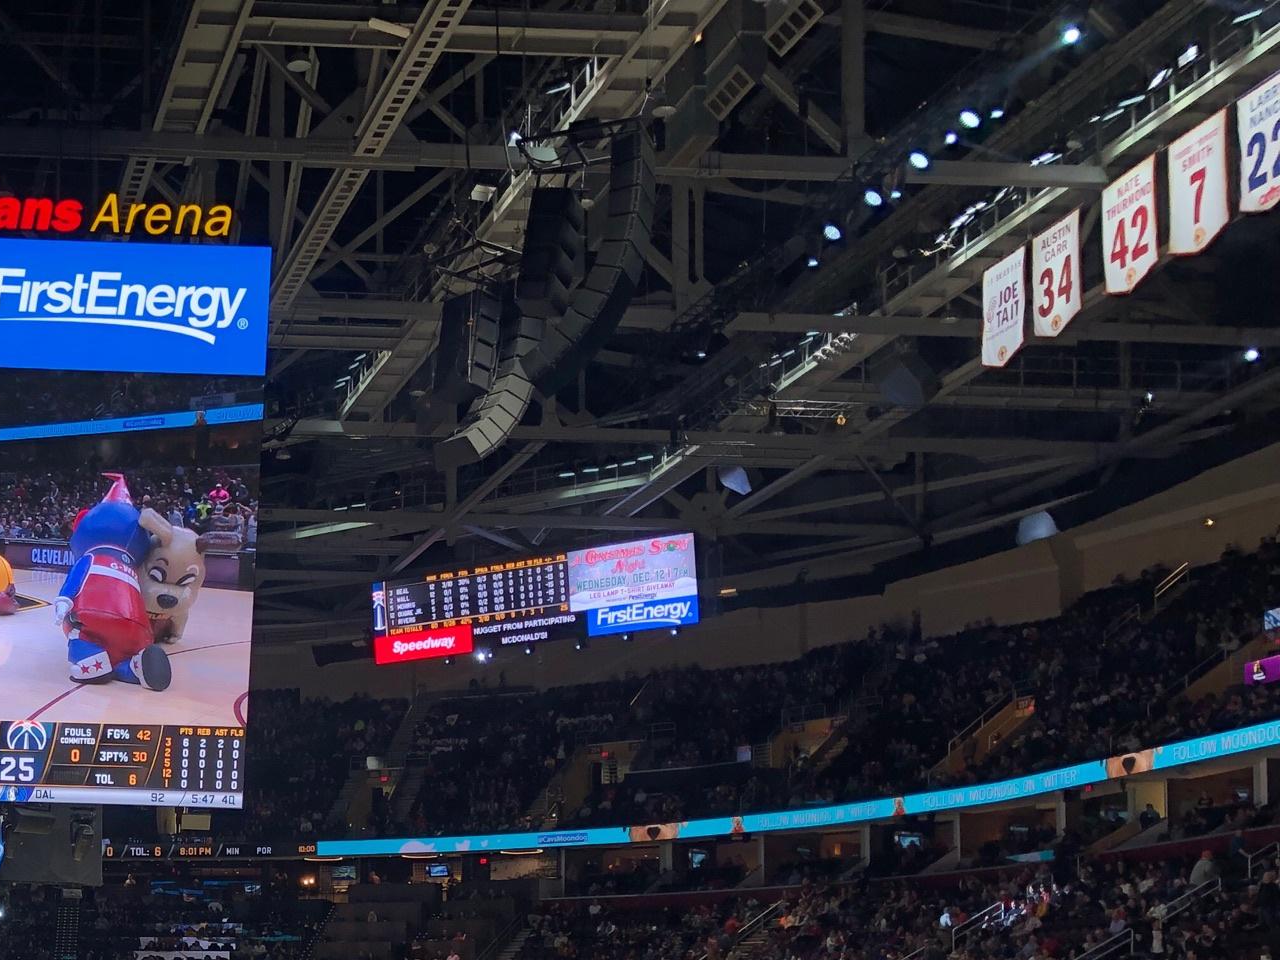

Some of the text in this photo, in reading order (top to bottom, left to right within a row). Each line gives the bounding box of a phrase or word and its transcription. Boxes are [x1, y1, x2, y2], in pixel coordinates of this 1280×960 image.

[1116, 173, 1141, 197] NATE
[1189, 167, 1207, 225] 7
[90, 194, 231, 236] Arena
[1040, 225, 1071, 251] AUSTIN
[1110, 205, 1149, 270] 42
[1044, 240, 1068, 263] CARR
[998, 280, 1019, 306] JOE
[1038, 255, 1073, 318] 34
[996, 299, 1020, 327] TAIT
[31, 548, 75, 566] CLEVELAN
[577, 575, 629, 592] WEDNESDAY,
[655, 569, 665, 580] 12
[596, 601, 691, 626] FirstEnergy
[473, 614, 576, 636] NUGGET FROM PARTICIPATING
[392, 635, 455, 655] Speedway
[60, 737, 96, 746] COMMITTED
[64, 728, 92, 738] FOULS
[106, 728, 151, 741] FG% 42
[197, 728, 211, 736] REB
[214, 728, 229, 736] AST
[230, 729, 244, 737] FLS
[71, 749, 80, 763] 0
[99, 750, 148, 763] 3PT% 30
[0, 756, 35, 782] 25
[95, 773, 137, 785] TOL 6
[35, 788, 166, 803] DAL 92
[190, 793, 215, 805] 5:47
[106, 846, 272, 857] 0 TOL: 6 8:01 PM MIN POR
